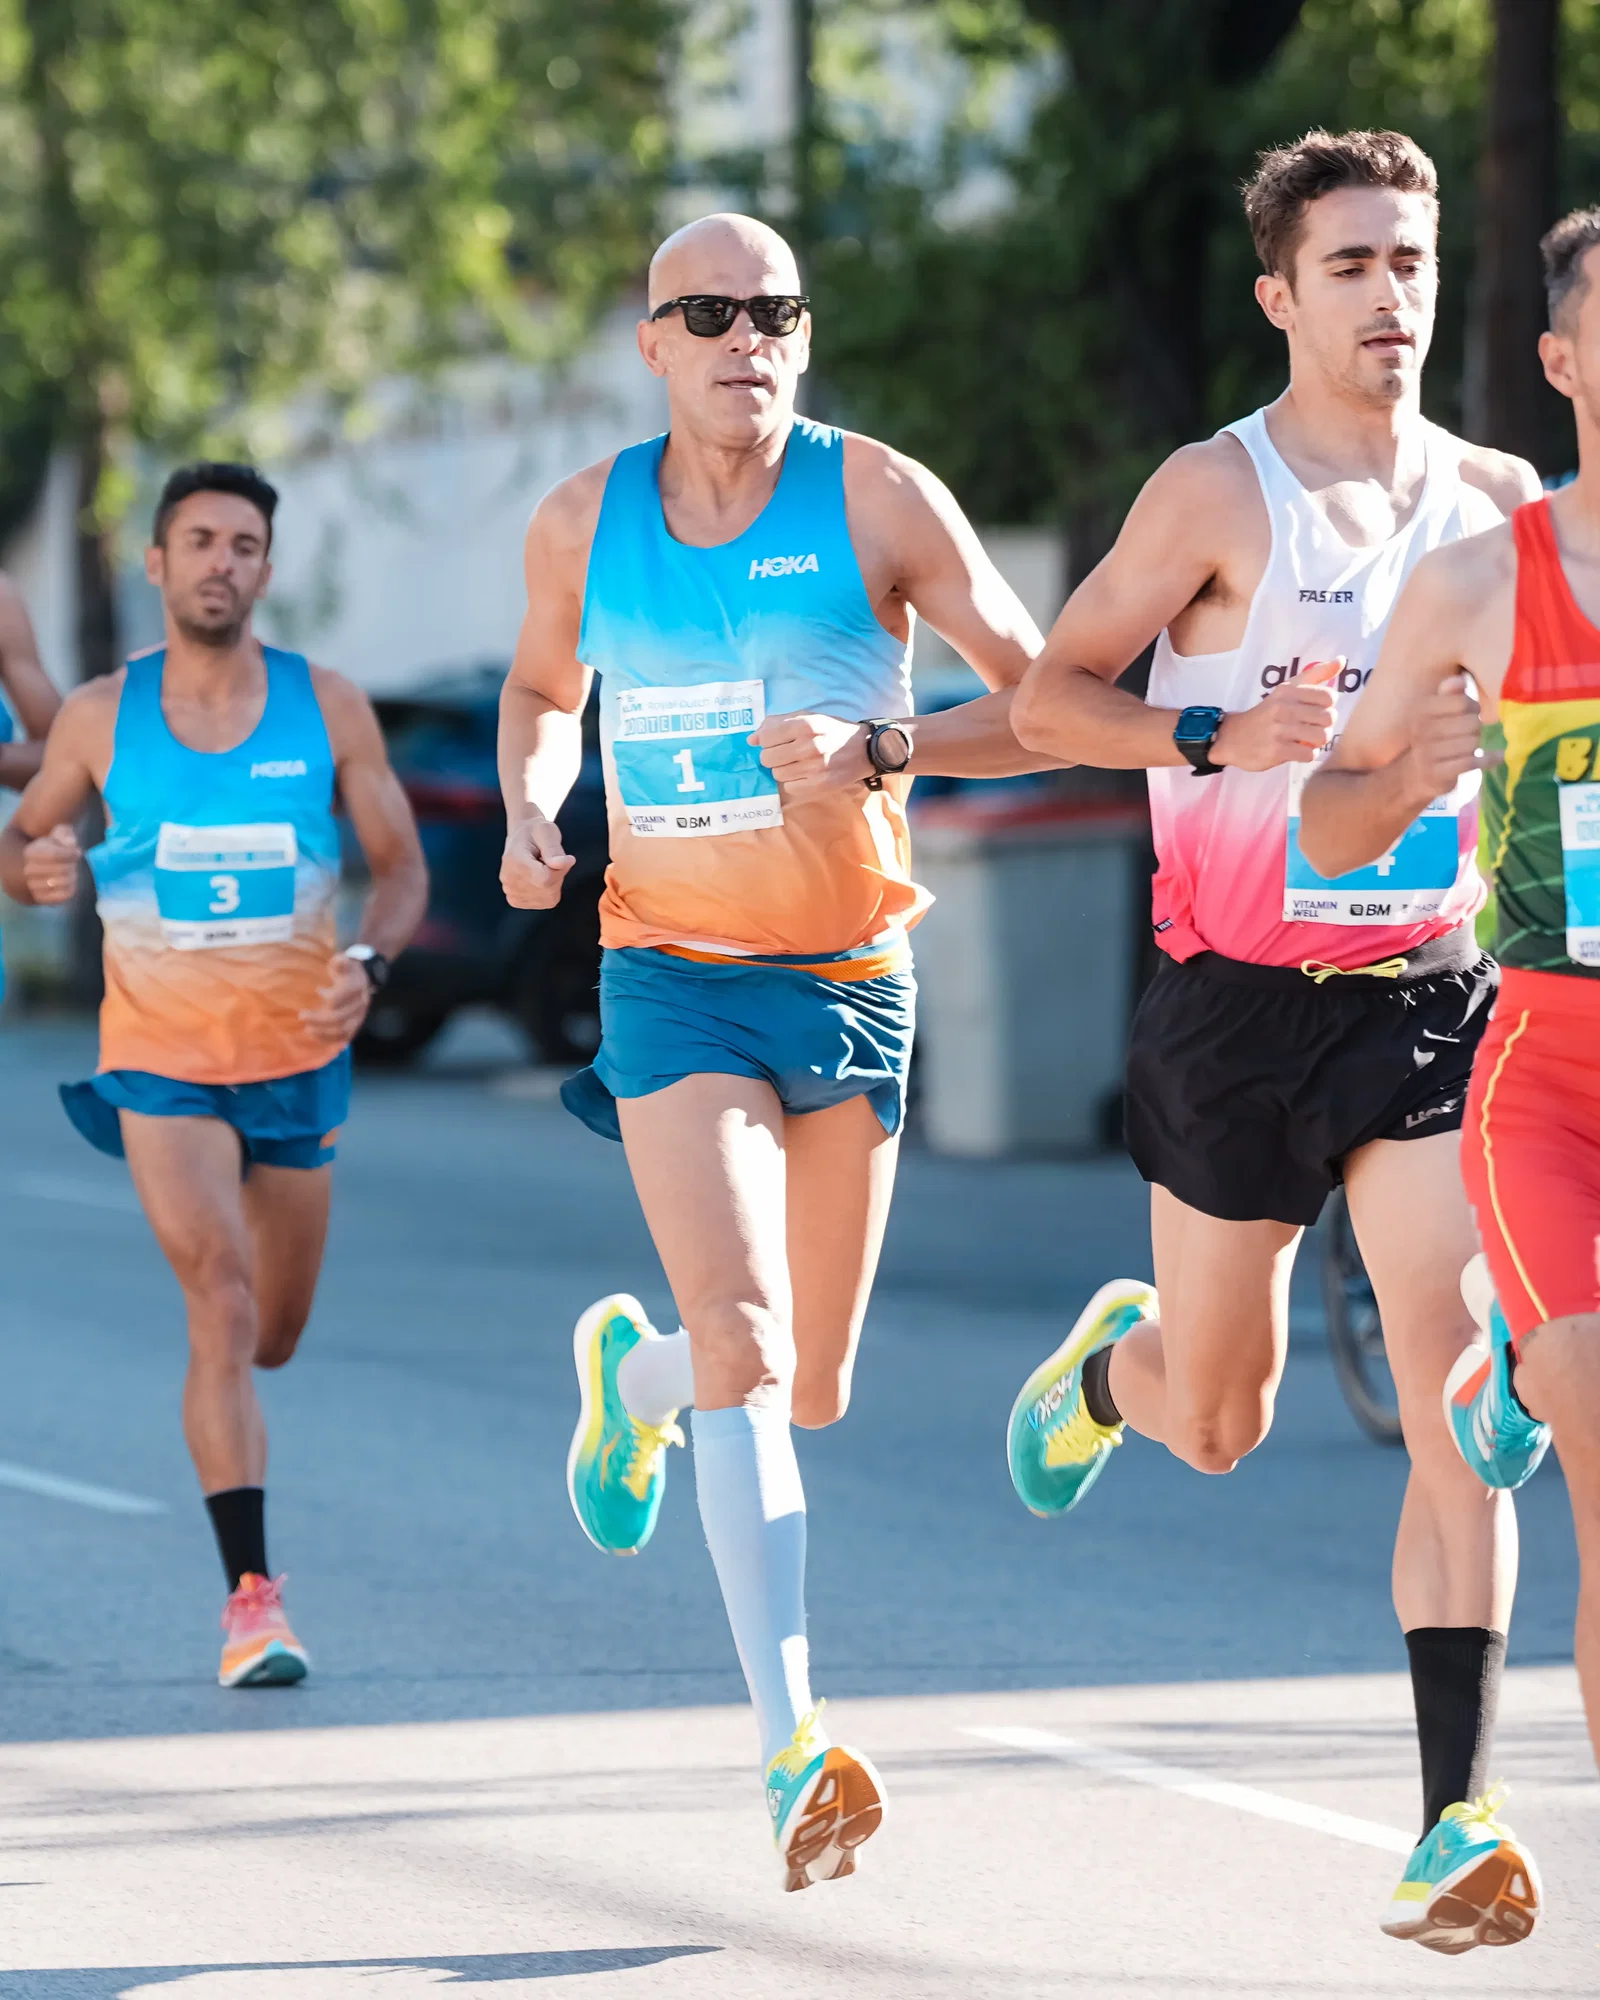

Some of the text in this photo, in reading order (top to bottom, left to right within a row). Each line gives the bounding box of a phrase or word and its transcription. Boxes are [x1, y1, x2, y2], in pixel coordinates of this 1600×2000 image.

[748, 553, 819, 580] HOKA
[1299, 590, 1354, 603] FASTER
[682, 712, 705, 731] VS
[718, 708, 753, 728] SUR
[672, 749, 705, 793] 1
[632, 815, 666, 825] VITAMIN
[733, 809, 773, 820] MADRID
[209, 875, 240, 914] 3
[1293, 900, 1337, 909] VITAMIN
[1366, 904, 1391, 916] BM
[1293, 909, 1320, 918] WELL
